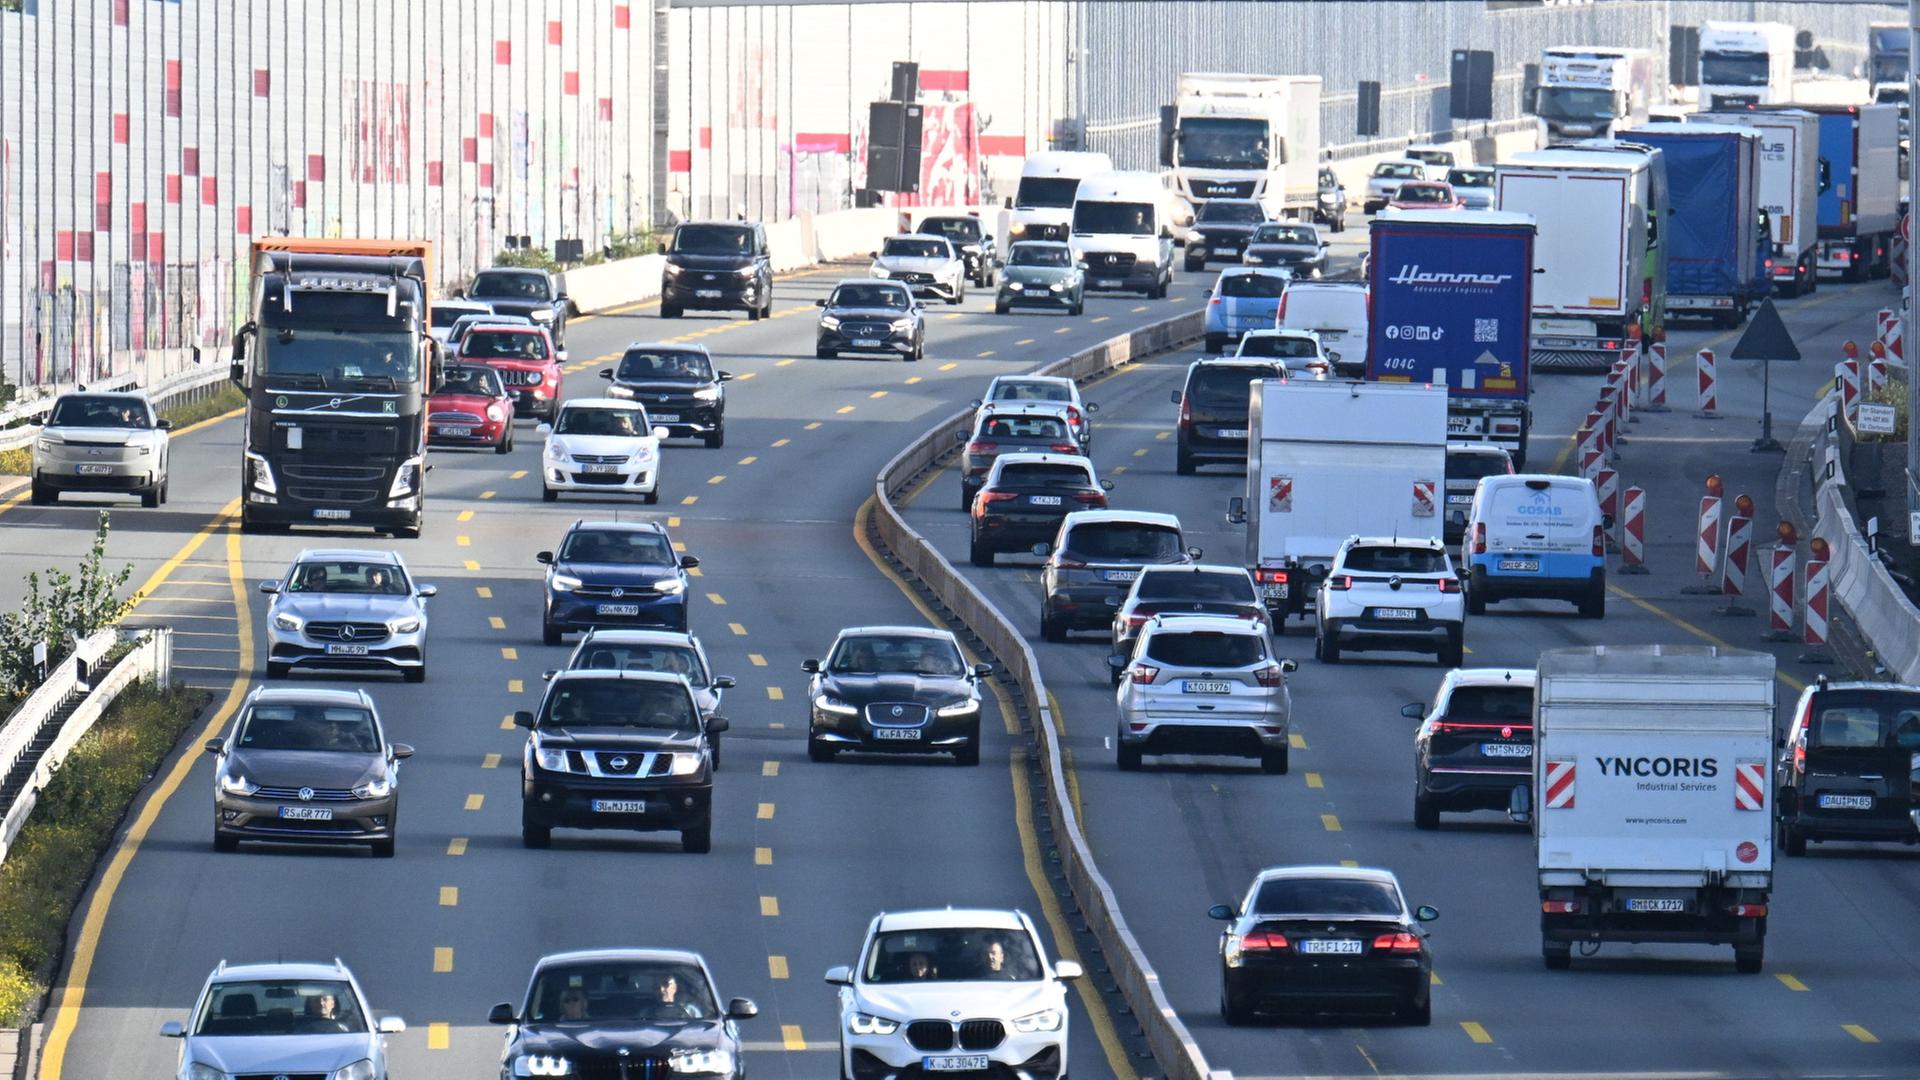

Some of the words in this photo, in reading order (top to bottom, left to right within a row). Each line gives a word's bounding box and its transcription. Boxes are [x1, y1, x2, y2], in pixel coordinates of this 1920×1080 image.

[1206, 186, 1238, 194] MAN
[1388, 264, 1513, 285] Hammer
[1383, 357, 1416, 370] 404C
[1594, 756, 1719, 778] YNCORIS
[1636, 782, 1678, 792] Industrial
[1679, 782, 1718, 793] Services
[1624, 816, 1688, 825] www.yncoris.com
[1661, 900, 1683, 911] 1717
[1342, 941, 1360, 952] 217
